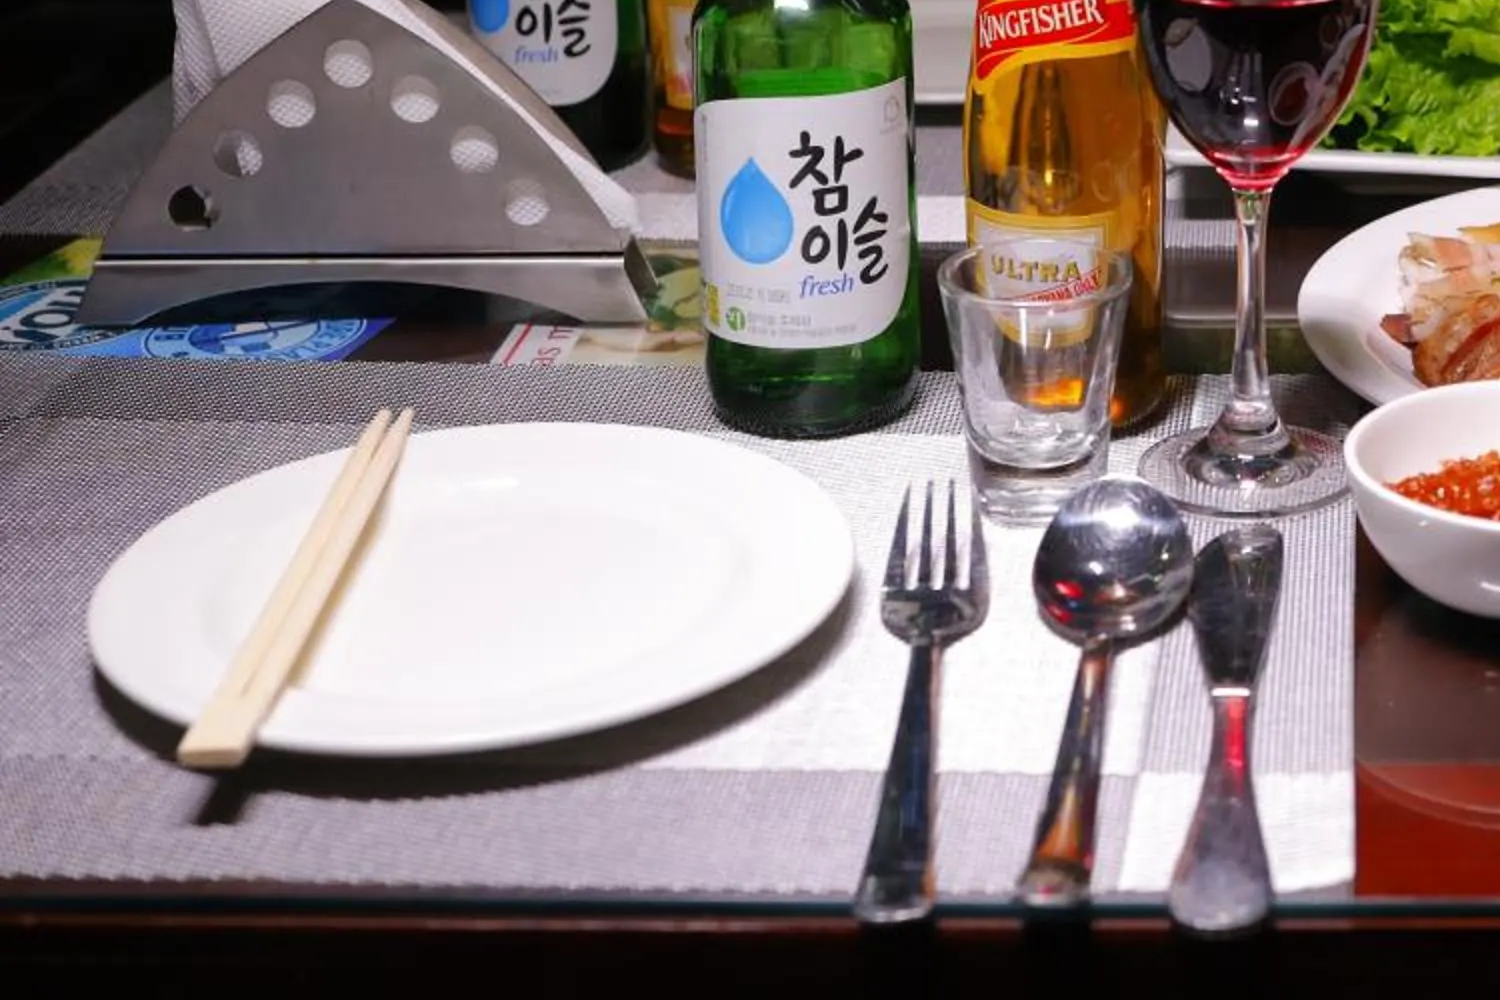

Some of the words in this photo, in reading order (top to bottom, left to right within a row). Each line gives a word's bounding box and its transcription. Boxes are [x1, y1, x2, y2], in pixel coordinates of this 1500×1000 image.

[788, 130, 864, 217] 참
[800, 196, 889, 285] 이슬
[991, 254, 1081, 283] ULTRA
[799, 272, 855, 299] fresh
